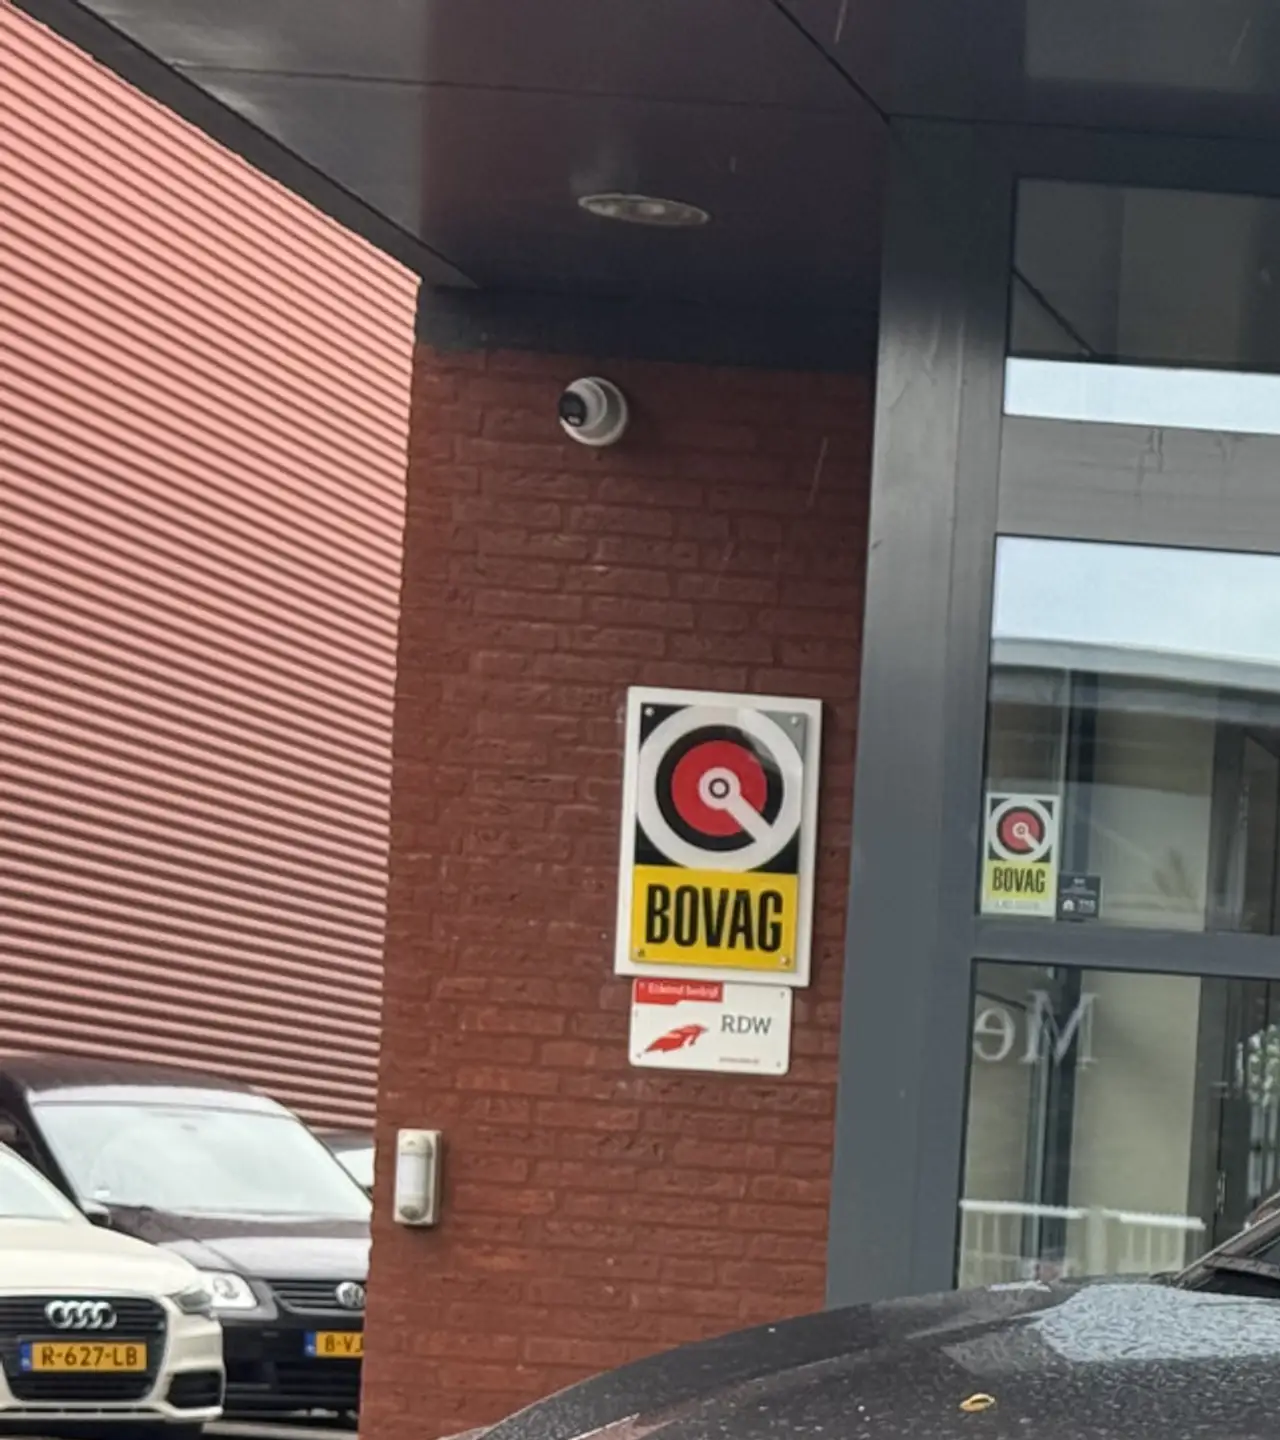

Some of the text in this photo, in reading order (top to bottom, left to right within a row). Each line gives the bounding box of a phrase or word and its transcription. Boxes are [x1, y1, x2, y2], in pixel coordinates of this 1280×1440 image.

[992, 866, 1046, 893] BOVAG
[646, 883, 784, 953] BOVAG
[720, 1014, 772, 1036] RDW
[41, 1345, 138, 1366] R-627-LB
